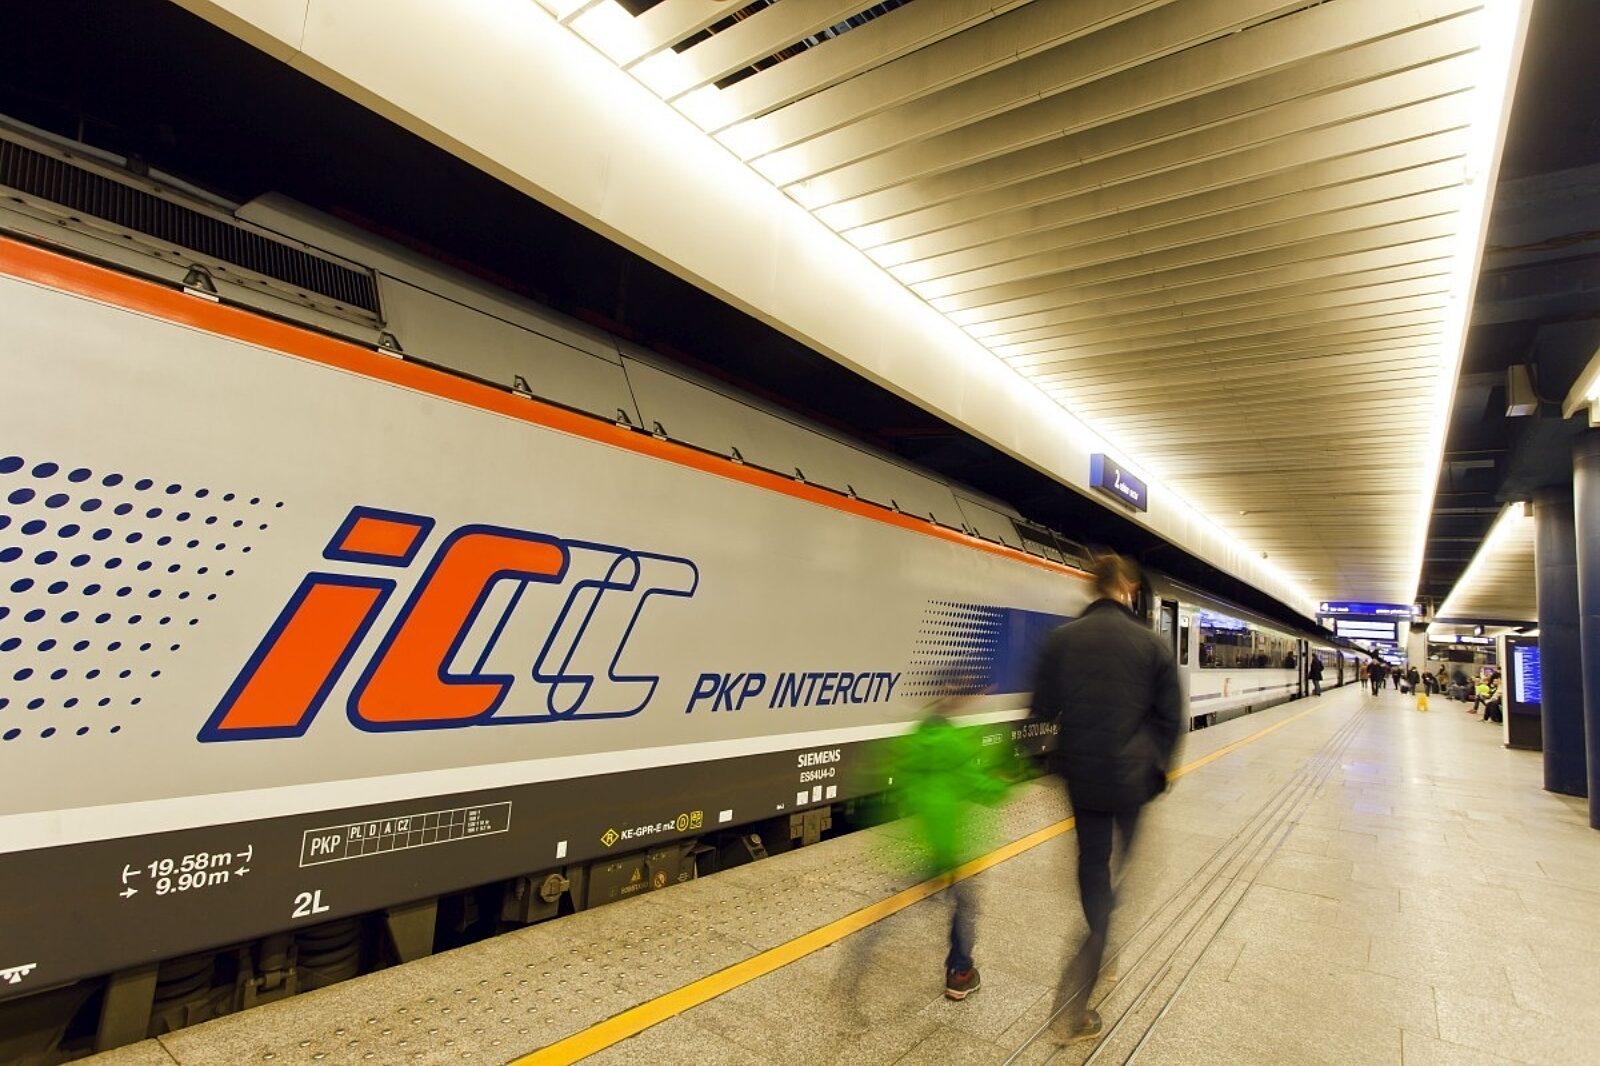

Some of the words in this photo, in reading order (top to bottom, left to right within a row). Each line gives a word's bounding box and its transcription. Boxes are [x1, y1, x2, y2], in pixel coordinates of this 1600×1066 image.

[685, 672, 767, 714] PKP
[768, 671, 902, 709] INTERCITY
[797, 749, 841, 768] SIEMENS
[800, 767, 836, 783] ES64U4-D
[350, 826, 362, 839] PL
[369, 824, 377, 836] D
[384, 821, 392, 834] A
[397, 819, 409, 832] CZ
[620, 822, 662, 841] KE-GPR-E
[310, 834, 341, 856] PKP
[147, 851, 232, 879] 19.58m
[155, 868, 229, 895] 9.90m
[291, 890, 330, 918] 2L
